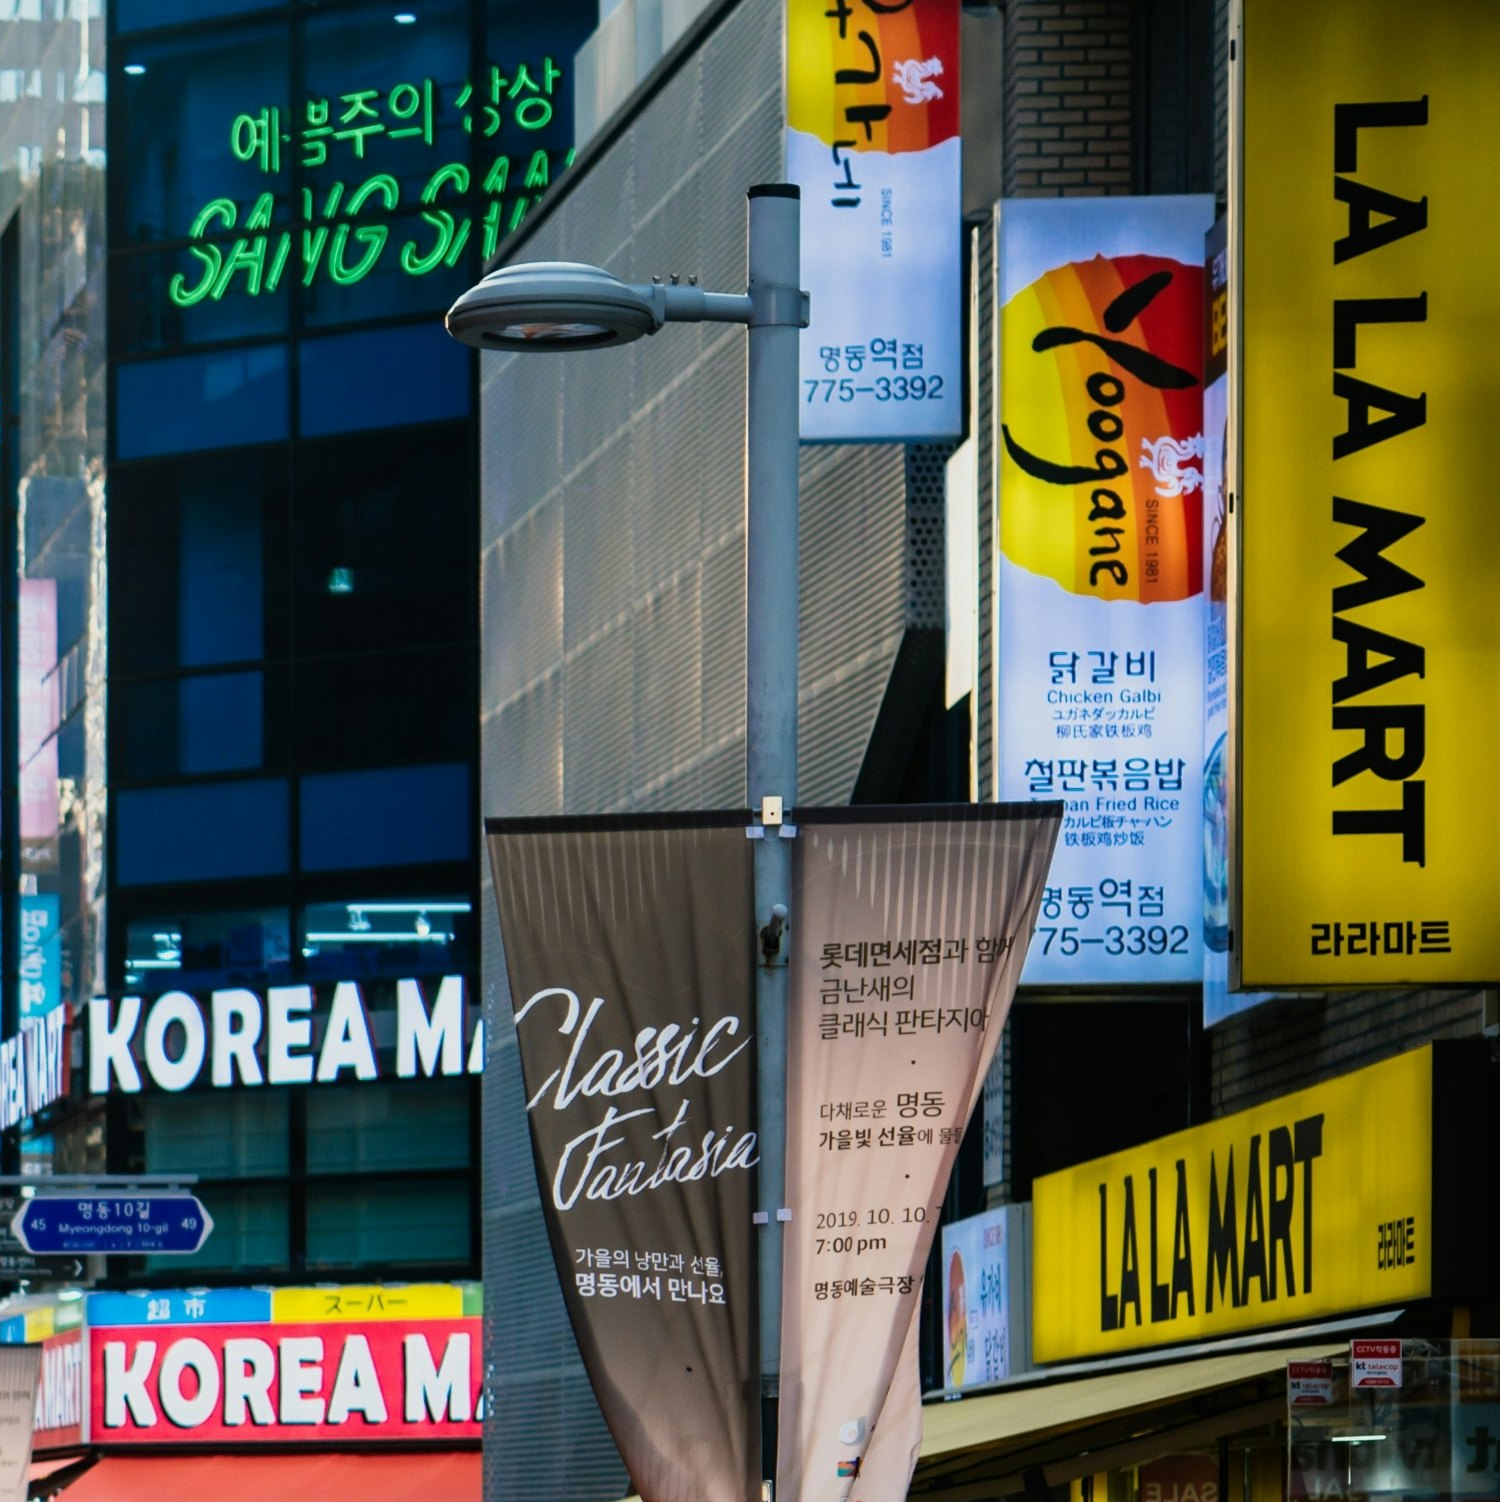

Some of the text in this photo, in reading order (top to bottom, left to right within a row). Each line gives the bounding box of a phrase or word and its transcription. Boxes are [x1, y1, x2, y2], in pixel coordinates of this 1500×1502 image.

[168, 174, 401, 307] SANG
[880, 188, 893, 260] SINCE 1981
[819, 337, 924, 373] 명동역점
[803, 375, 945, 403] 775-3392
[1002, 269, 1200, 588] Yoogane
[1330, 93, 1429, 870] LA LA MART
[1145, 498, 1160, 585] SINCE 1981
[1047, 650, 1156, 686] 닭갈비
[1046, 688, 1162, 705] Chicken Galbi
[1051, 707, 1156, 722] ユガネダッカルビ
[1055, 723, 1153, 739] 柳氏家铁板鸡
[1023, 757, 1187, 793] 철판볶음밥
[1095, 796, 1180, 812] Fried Rice
[1064, 830, 1146, 848] 铁板鸡炒饭
[1041, 877, 1165, 920] 명동역점
[819, 936, 969, 971] 롯데면세점과
[1032, 924, 1189, 957] 75-3392
[1310, 920, 1453, 958] 라라마트
[819, 974, 916, 1006] 금난새의
[89, 980, 379, 1094] KOREA
[818, 1006, 990, 1041] 클래식 판타지아
[25, 1003, 67, 1122] MART
[513, 987, 754, 1113] Classic
[819, 1090, 946, 1123] 다채로운 명동
[552, 1099, 761, 1211] Fantasia
[818, 1124, 935, 1153] 가을빛 선율에
[30, 1217, 198, 1236] 45 Myeongdong 10-gil 49
[77, 1201, 151, 1220] 명동10길
[815, 1205, 931, 1232] 2019. 10. 10.
[1098, 1112, 1326, 1333] LA LA MART
[575, 1247, 631, 1269] 가을의
[634, 1249, 687, 1276] 낭만과
[815, 1236, 888, 1256] 7:00 pm
[1376, 1216, 1416, 1272] 라라마트
[323, 1293, 408, 1315] スーパー
[574, 1270, 727, 1305] 명동에서 만나요
[813, 1275, 916, 1301] 명동예술극장
[103, 1334, 389, 1430] KOREA
[1355, 1361, 1399, 1372] kt telecop
